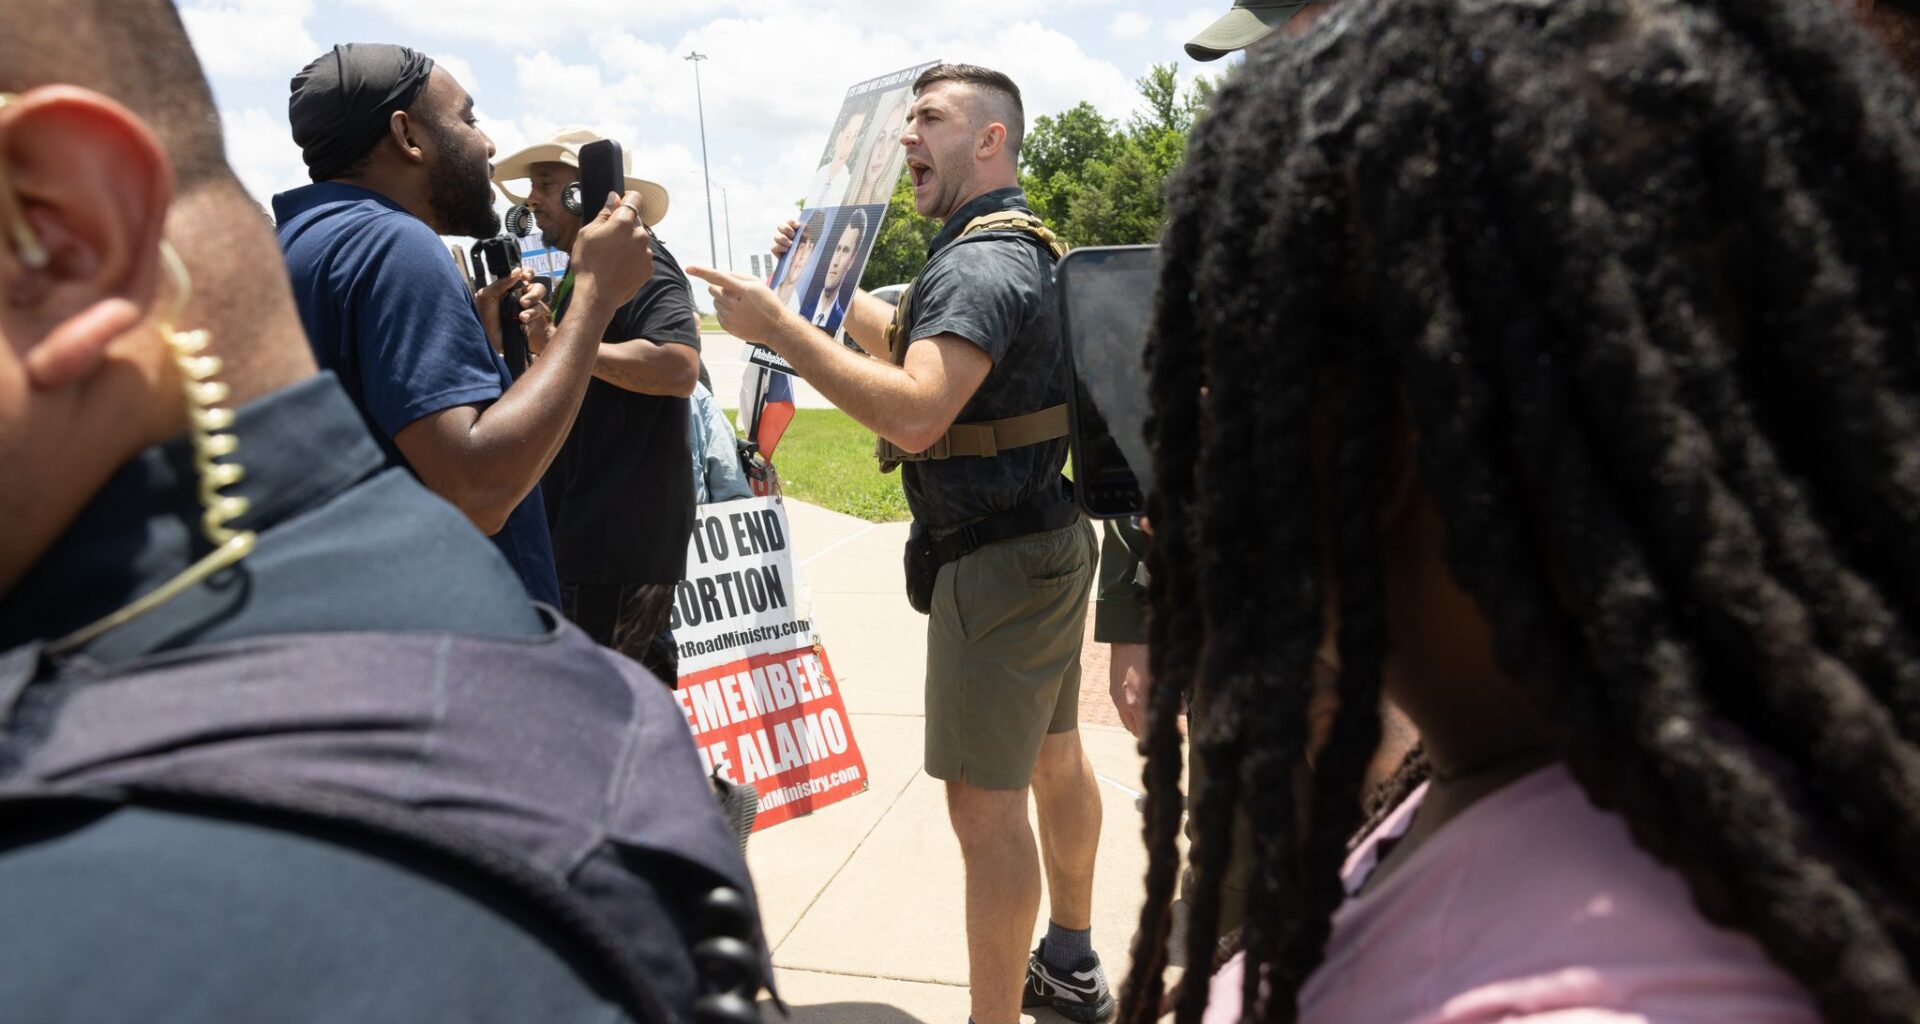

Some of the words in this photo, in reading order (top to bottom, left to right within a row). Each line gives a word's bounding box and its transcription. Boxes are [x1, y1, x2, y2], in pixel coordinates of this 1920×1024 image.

[879, 74, 899, 88] STAND
[692, 516, 729, 564] TO
[729, 509, 786, 557] END
[673, 654, 832, 736] EMEMBER
[737, 707, 848, 784] ALAMO
